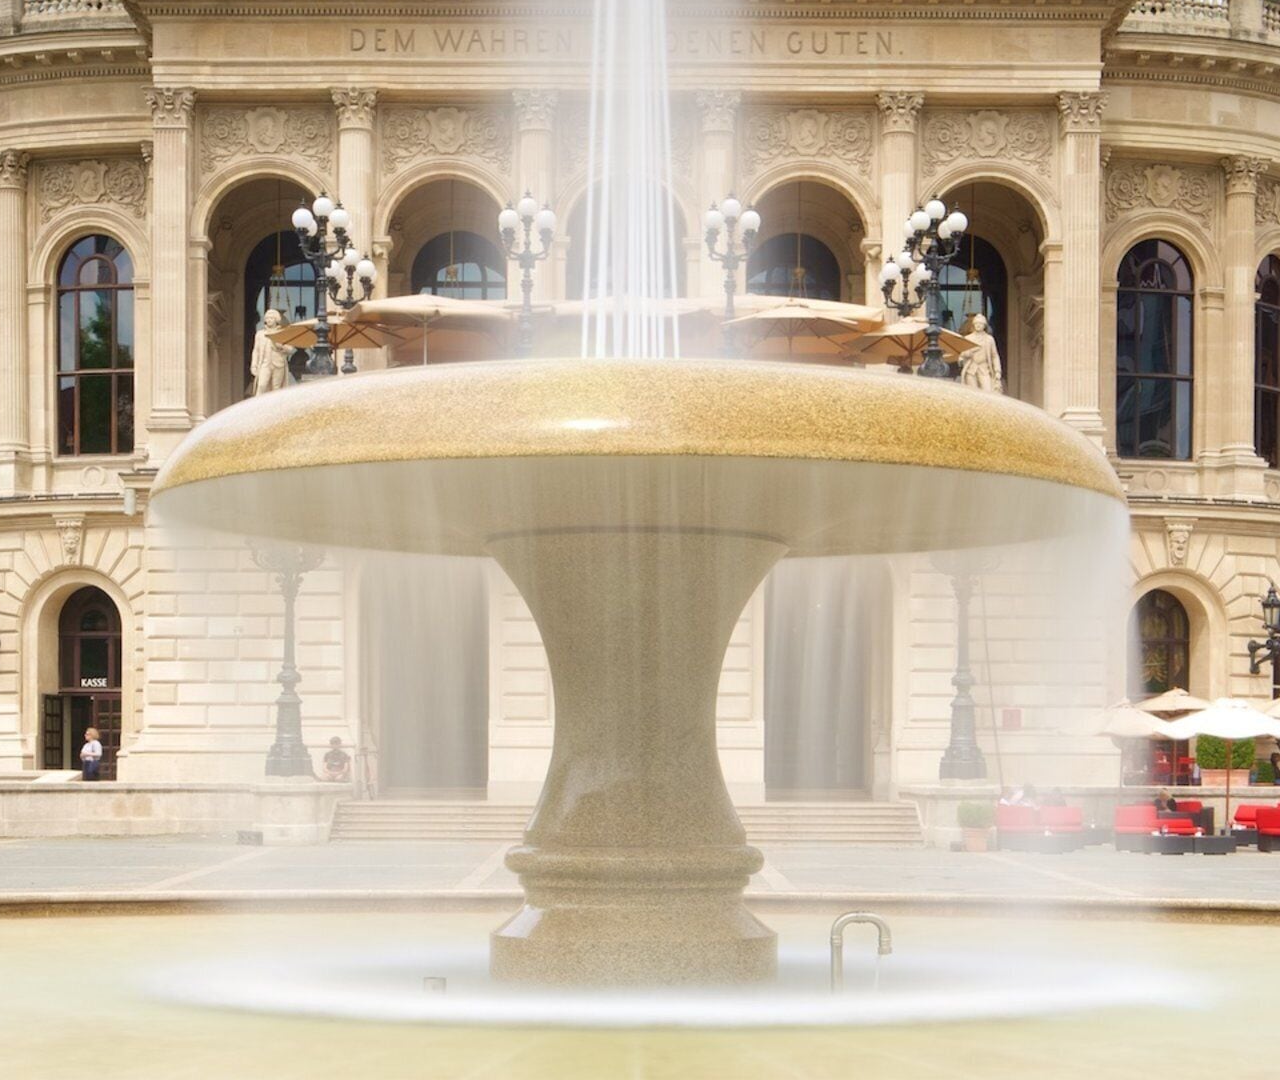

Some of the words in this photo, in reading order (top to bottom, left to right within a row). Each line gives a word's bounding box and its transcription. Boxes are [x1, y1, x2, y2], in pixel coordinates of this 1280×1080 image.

[349, 28, 416, 53] DEM
[433, 28, 574, 53] WAHREN
[80, 678, 108, 688] KASSE
